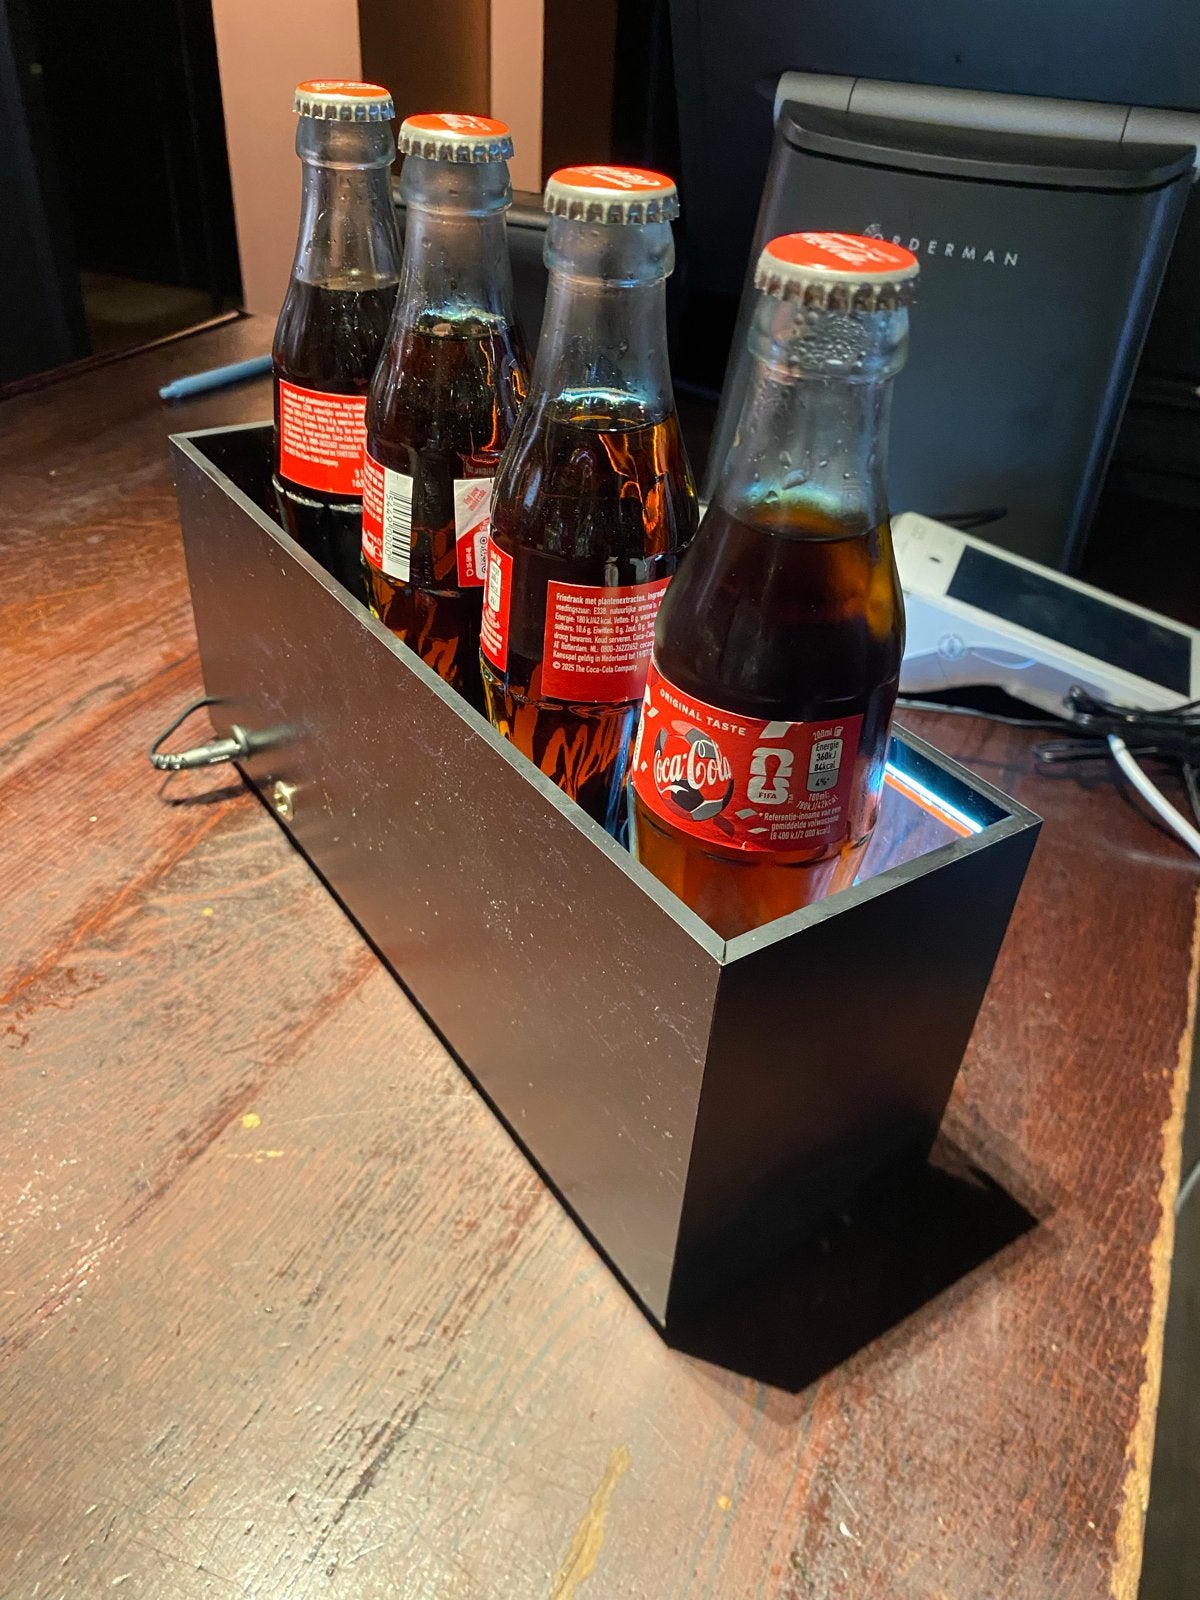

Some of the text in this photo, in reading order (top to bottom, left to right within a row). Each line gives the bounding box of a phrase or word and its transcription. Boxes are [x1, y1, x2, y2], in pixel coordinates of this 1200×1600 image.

[576, 664, 585, 672] The
[586, 665, 614, 673] Coca-Cola
[660, 688, 747, 737] ORIGINAL TASTE
[816, 740, 839, 752] Energie
[654, 739, 732, 794] Coca-Cola
[759, 791, 777, 800] FIFA
[771, 820, 807, 831] gemiddelde
